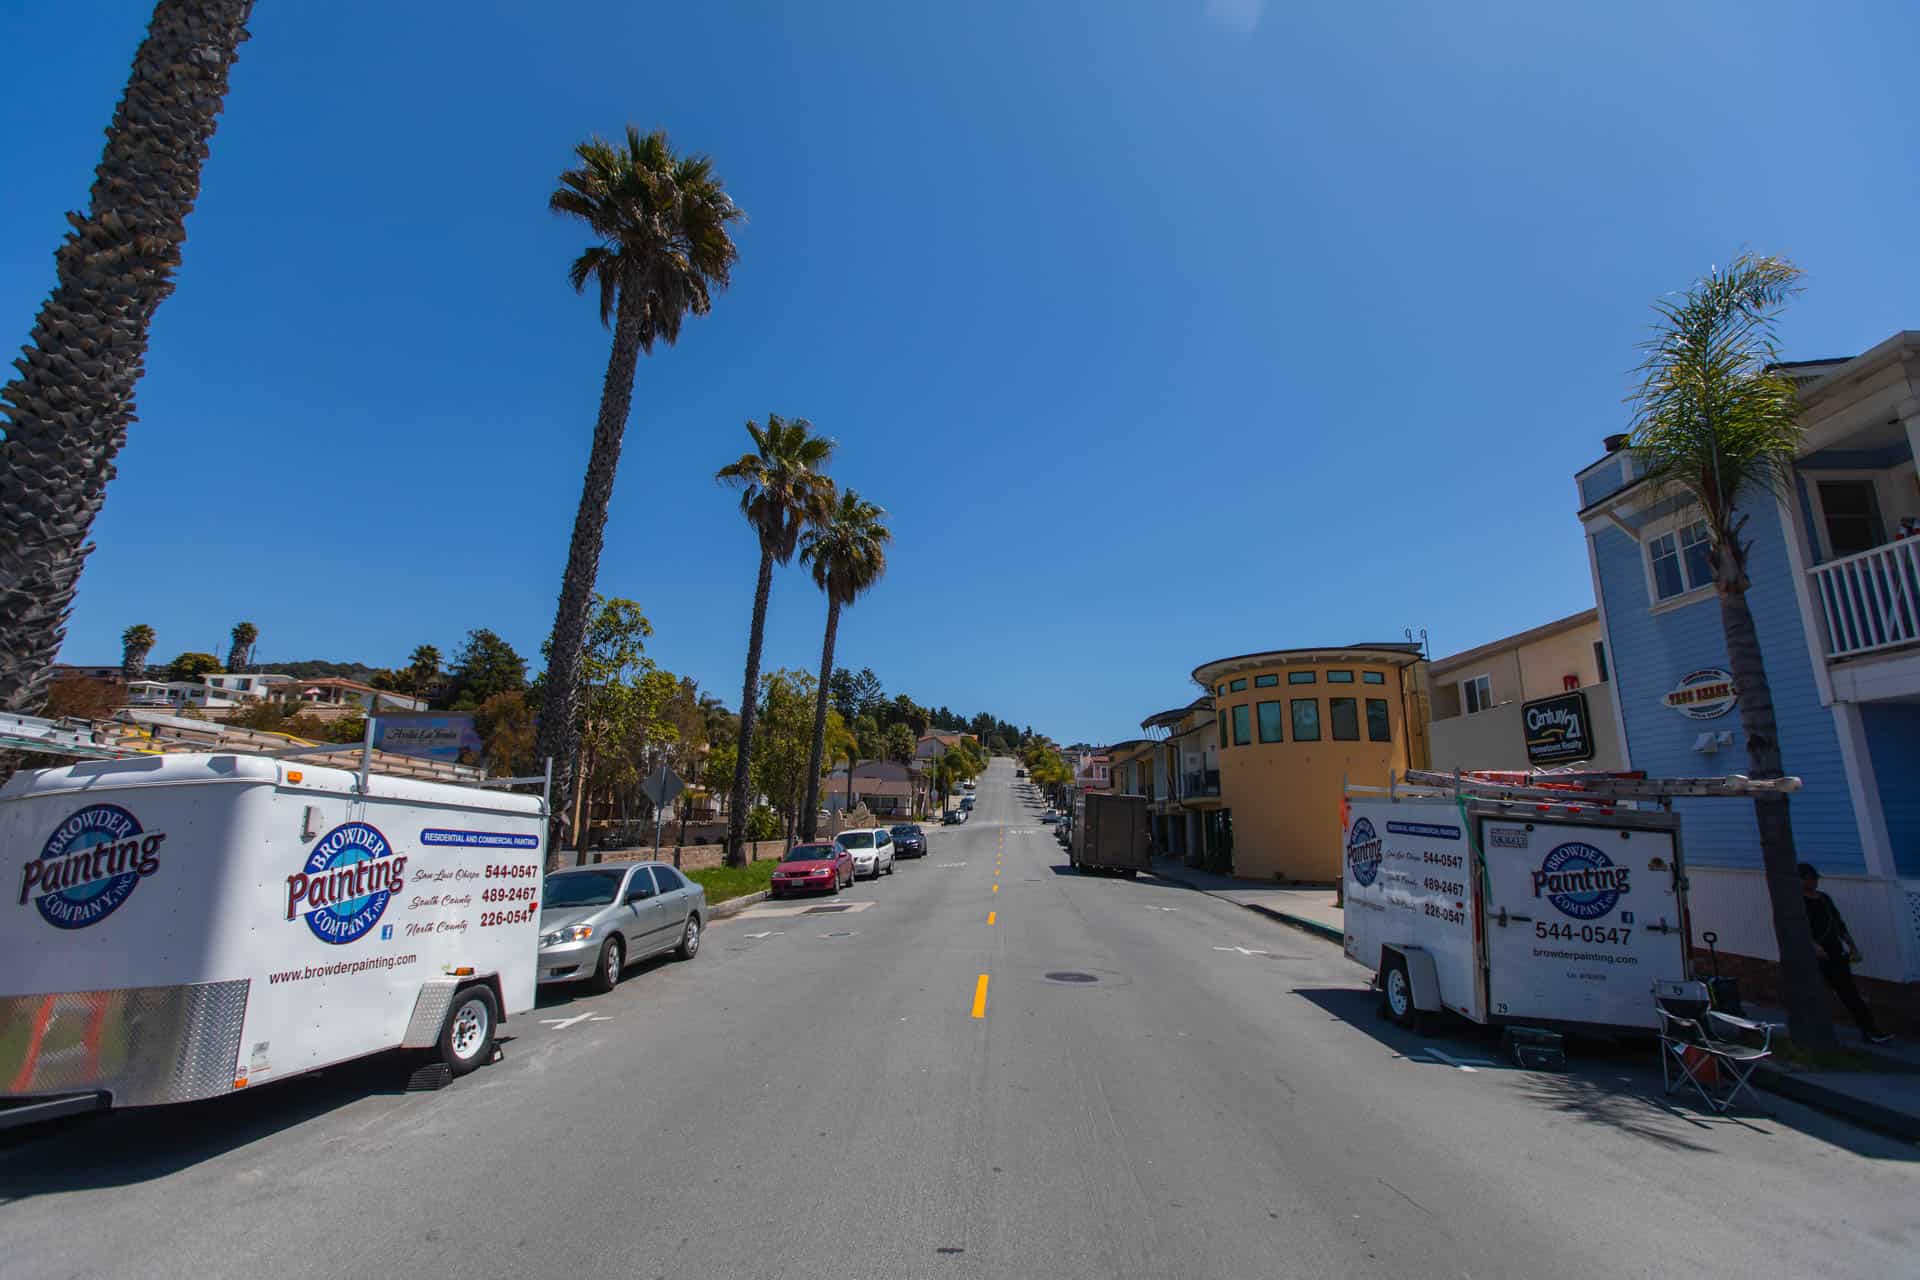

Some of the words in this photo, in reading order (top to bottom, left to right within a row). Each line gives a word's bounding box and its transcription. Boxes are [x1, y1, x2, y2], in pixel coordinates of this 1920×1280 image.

[1527, 707, 1568, 730] Century
[1565, 713, 1581, 738] 21
[48, 809, 132, 855] BROWDER
[424, 832, 464, 842] RESIDENTIAL
[466, 834, 478, 842] AND
[478, 835, 513, 845] COMMERCIAL
[311, 828, 385, 869] BROWDER
[1347, 839, 1383, 868] Painting
[1423, 851, 1463, 870] 544-0547
[1547, 846, 1607, 870] BROWDER
[18, 832, 166, 906] Painting
[410, 869, 433, 882] San
[485, 865, 538, 878] 544-0547
[1531, 865, 1631, 897] Painting
[286, 856, 408, 921] Painting
[408, 895, 439, 910] South
[441, 894, 472, 908] County
[482, 888, 537, 902] 489-2467
[1424, 877, 1464, 896] 489-2467
[314, 907, 377, 937] COMPANY,
[405, 922, 434, 937] North
[436, 920, 469, 935] County
[480, 909, 536, 927] 226-0547
[1424, 903, 1465, 925] 226-0547
[1535, 921, 1631, 945] 544-0547
[269, 953, 417, 985] www.browderpainting.com
[1533, 948, 1638, 965] browderpainting.com
